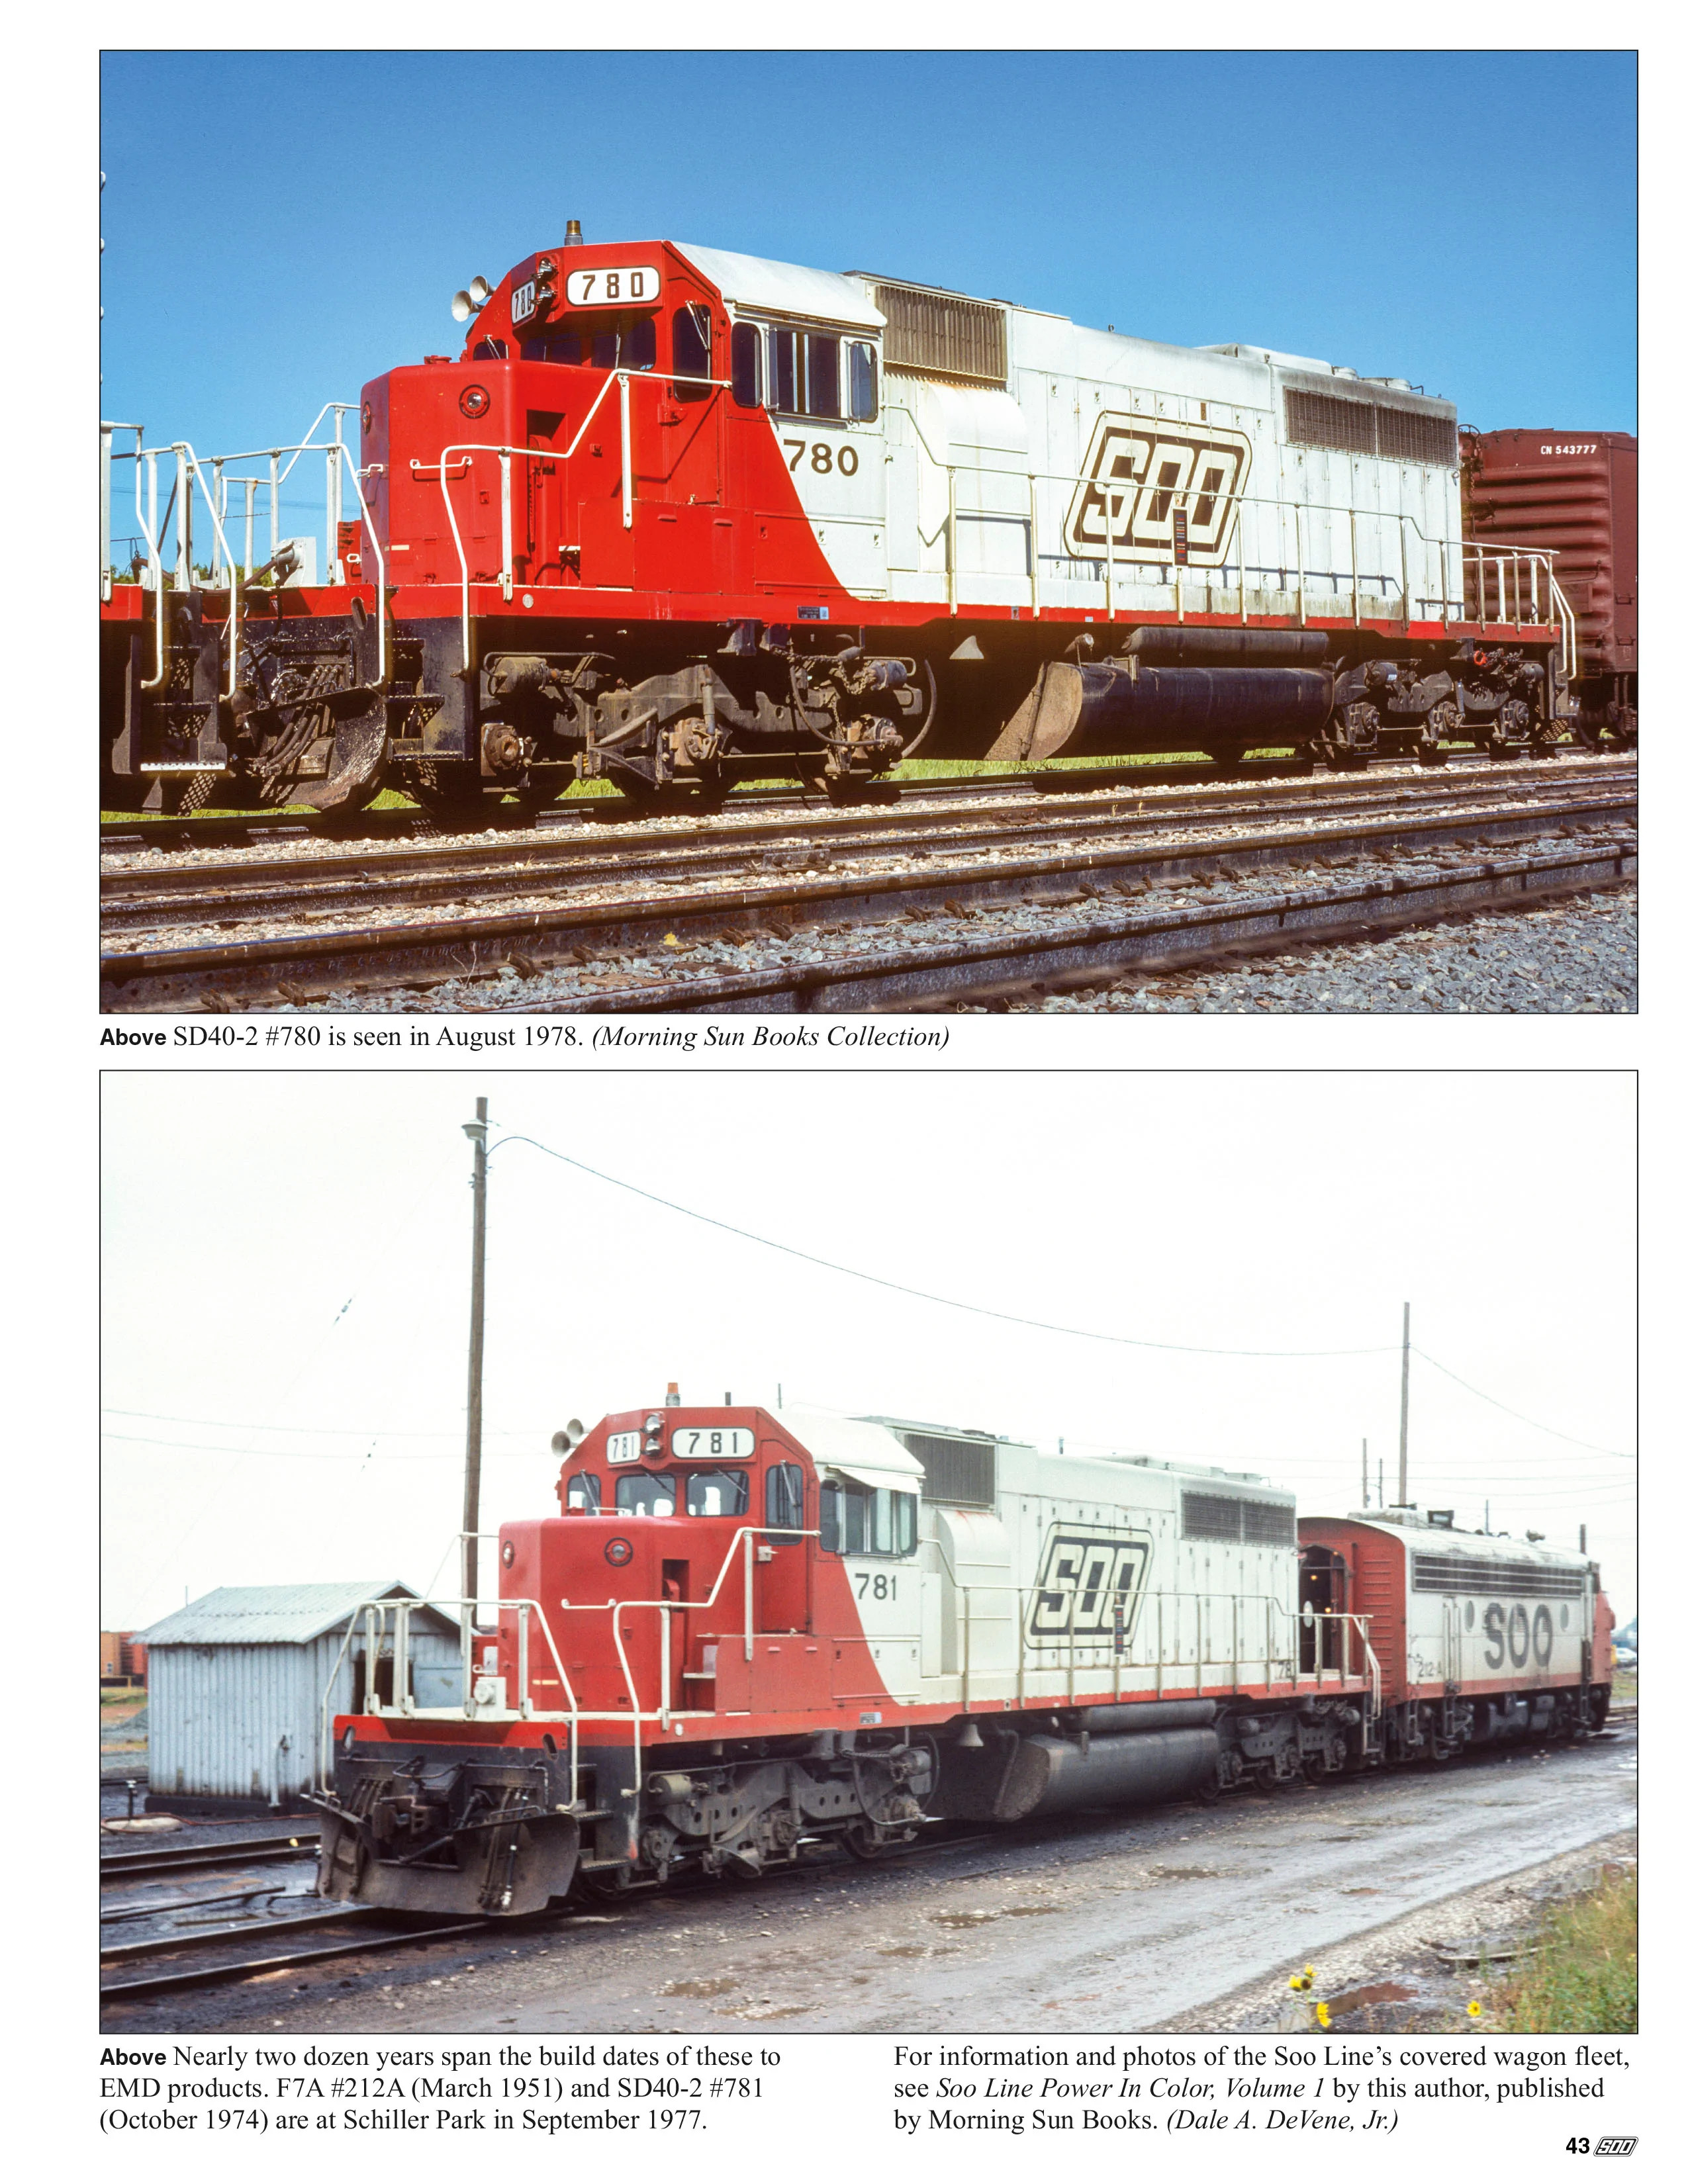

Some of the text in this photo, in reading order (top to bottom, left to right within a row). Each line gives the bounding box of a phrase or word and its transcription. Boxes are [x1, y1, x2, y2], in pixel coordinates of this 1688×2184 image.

[583, 271, 643, 300] 780
[514, 285, 532, 320] 780
[783, 438, 859, 477] 780
[1540, 444, 1597, 455] CN 543777
[1082, 435, 1238, 545] SOO
[99, 1025, 949, 1052] Above SD40-2 #780 is seen in August 1978. (Morning Sun Books Collection)
[613, 1435, 635, 1459] 781
[688, 1432, 738, 1455] 781
[854, 1572, 898, 1602] 781
[1036, 1543, 1145, 1628] SOO
[1483, 1602, 1553, 1670] SOO
[99, 2045, 780, 2071] Above Nearly two dozen years span the build dates of these to
[894, 2045, 1629, 2071] For information and photos of the Soo Line’s covered wagon fleet,
[99, 2077, 763, 2103] EMD products. F7A #212A (March 1951) and SD40-2 #781
[894, 2077, 1605, 2103] see Soo Line Power In Color, Volume 1 by this author, published
[100, 2109, 707, 2135] (October 1974) are at Schiller Park in September 1977.
[893, 2109, 1398, 2135] by Morning Sun Books. (Dale A. DeVene, Jr.)
[1566, 2137, 1634, 2154] 43 SOO
